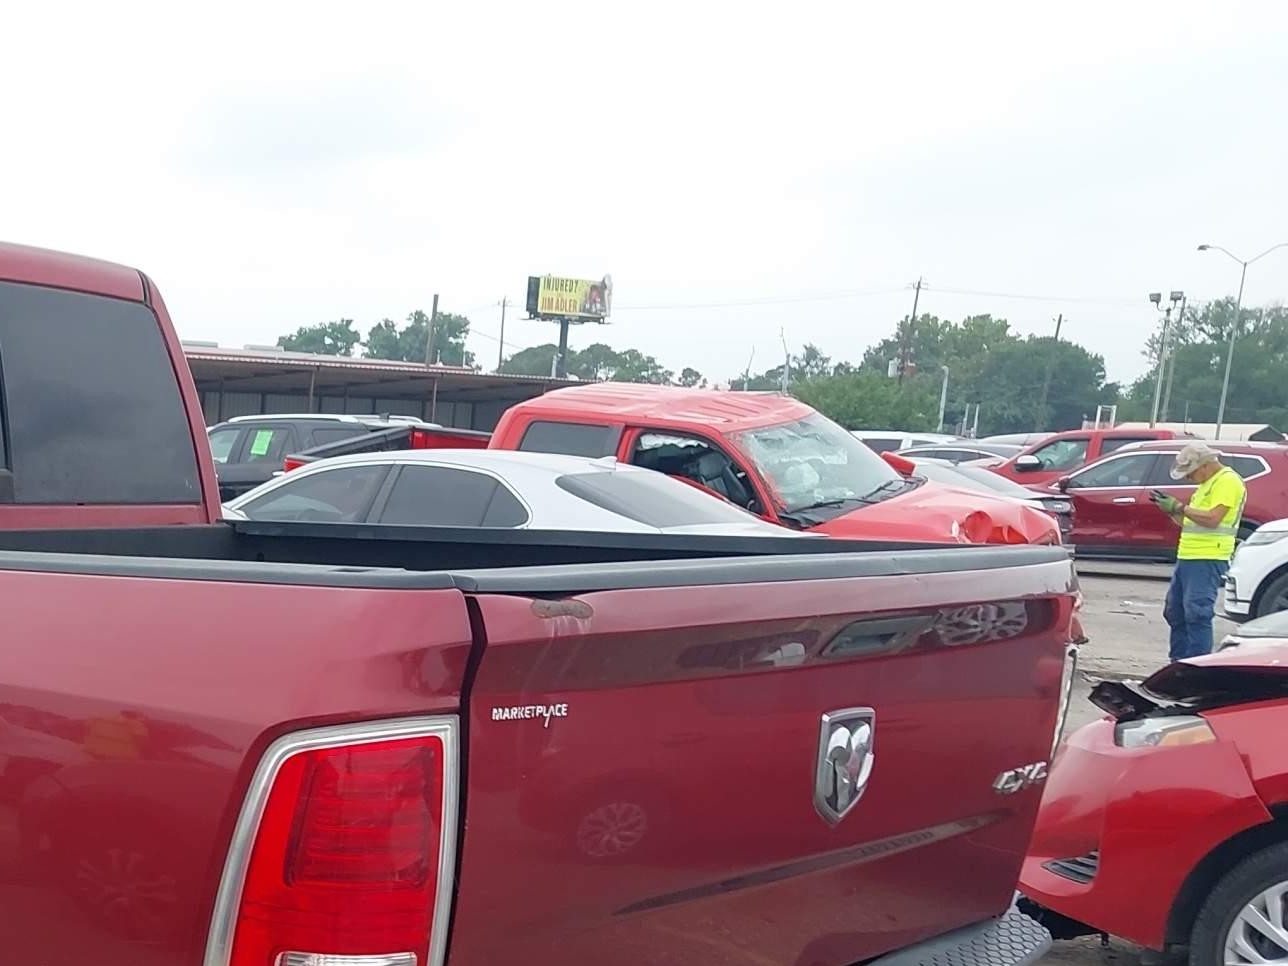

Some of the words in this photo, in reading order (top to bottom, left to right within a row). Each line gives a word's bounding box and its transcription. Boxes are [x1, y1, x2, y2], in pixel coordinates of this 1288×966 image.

[542, 296, 553, 311] JIM
[554, 297, 578, 313] ADLER
[492, 703, 569, 728] MARKETPLACE
